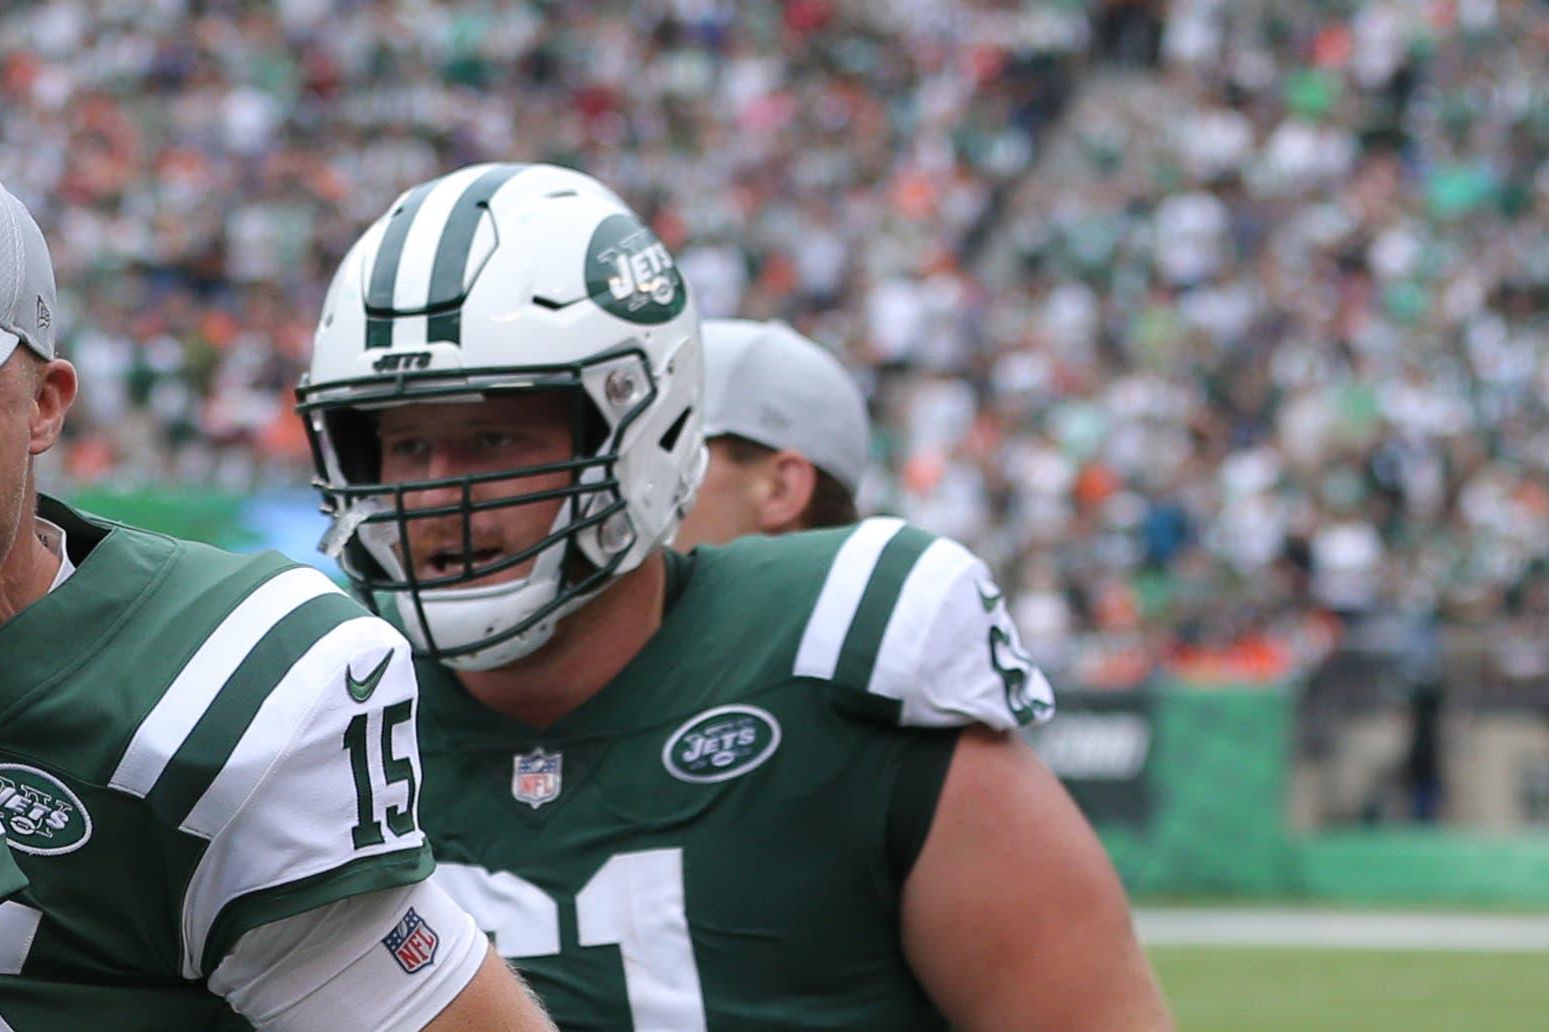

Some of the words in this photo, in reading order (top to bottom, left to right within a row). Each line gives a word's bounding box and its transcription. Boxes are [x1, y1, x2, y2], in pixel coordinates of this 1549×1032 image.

[682, 728, 757, 763] JETS
[343, 697, 417, 851] 15
[397, 928, 435, 969] NFL
